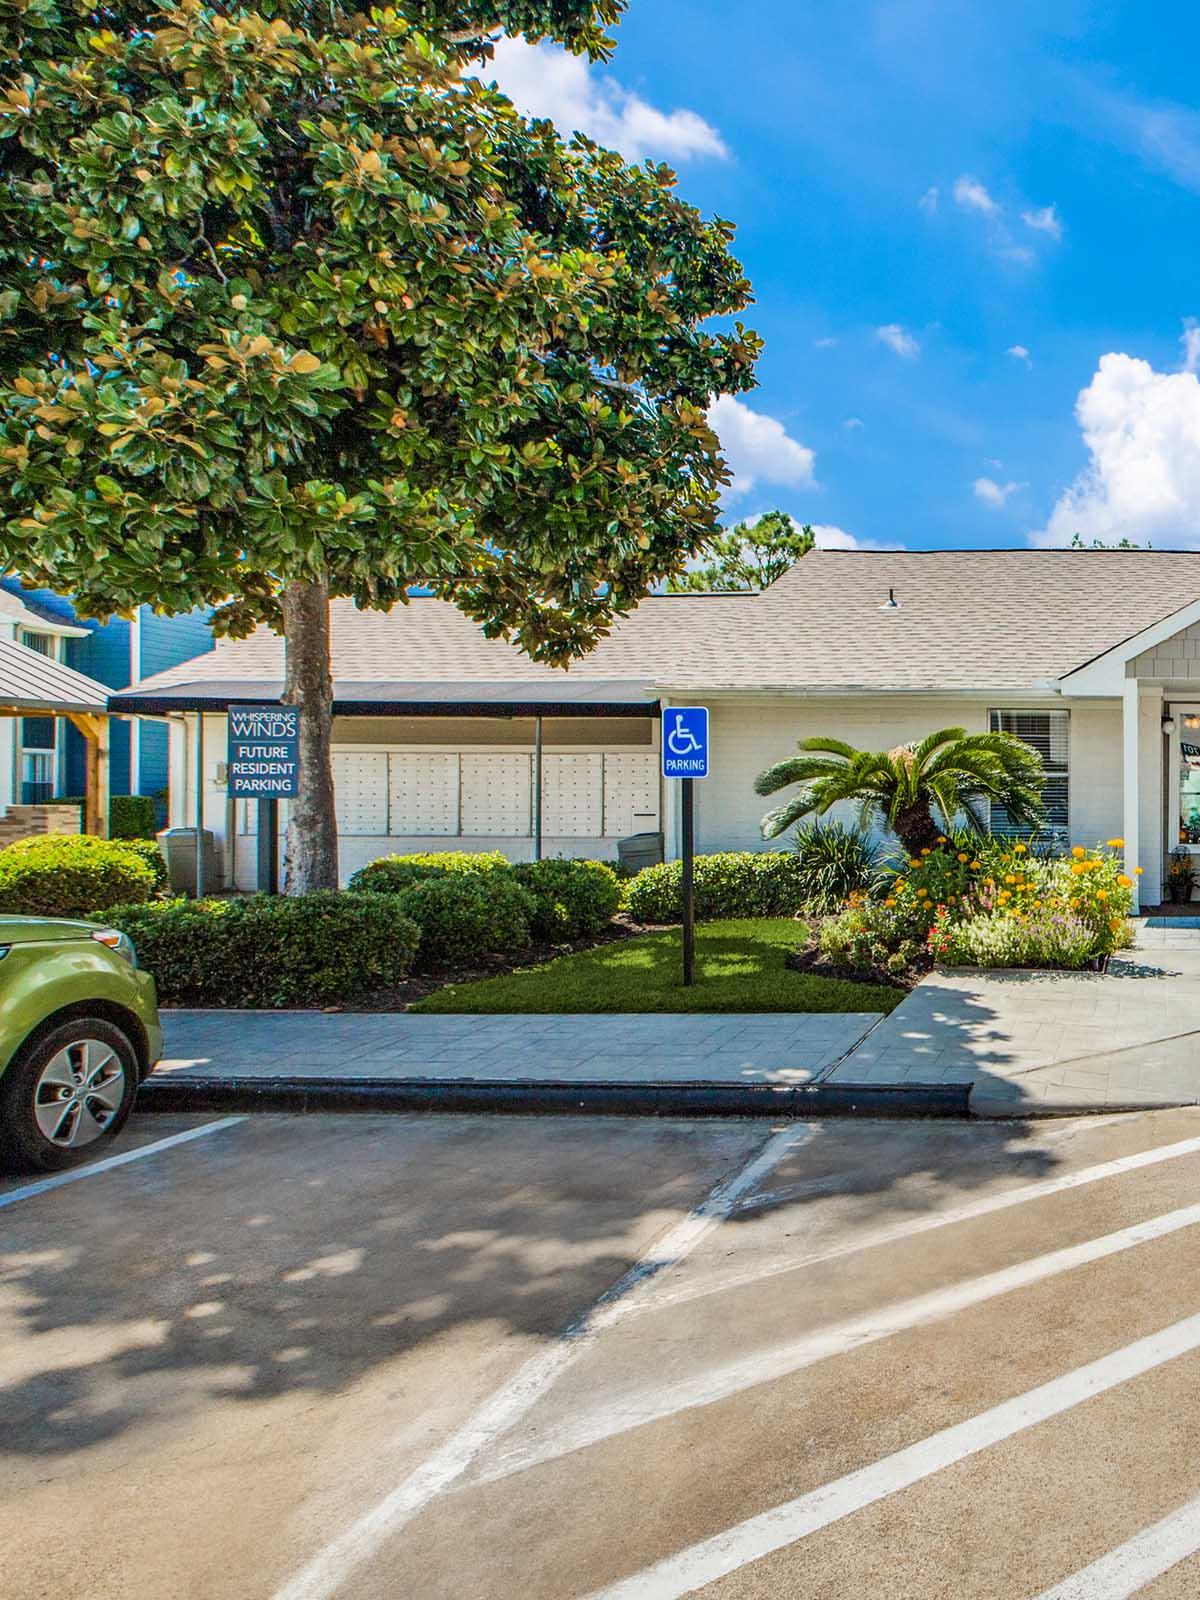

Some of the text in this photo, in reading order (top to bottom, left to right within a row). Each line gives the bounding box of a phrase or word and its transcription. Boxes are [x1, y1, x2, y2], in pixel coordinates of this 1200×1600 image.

[231, 712, 297, 722] WHISPERING
[231, 722, 297, 737] WINDS
[238, 746, 289, 758] FUTURE
[232, 763, 296, 775] RESIDENT
[666, 760, 705, 771] PARKING
[235, 779, 292, 791] PARKING
